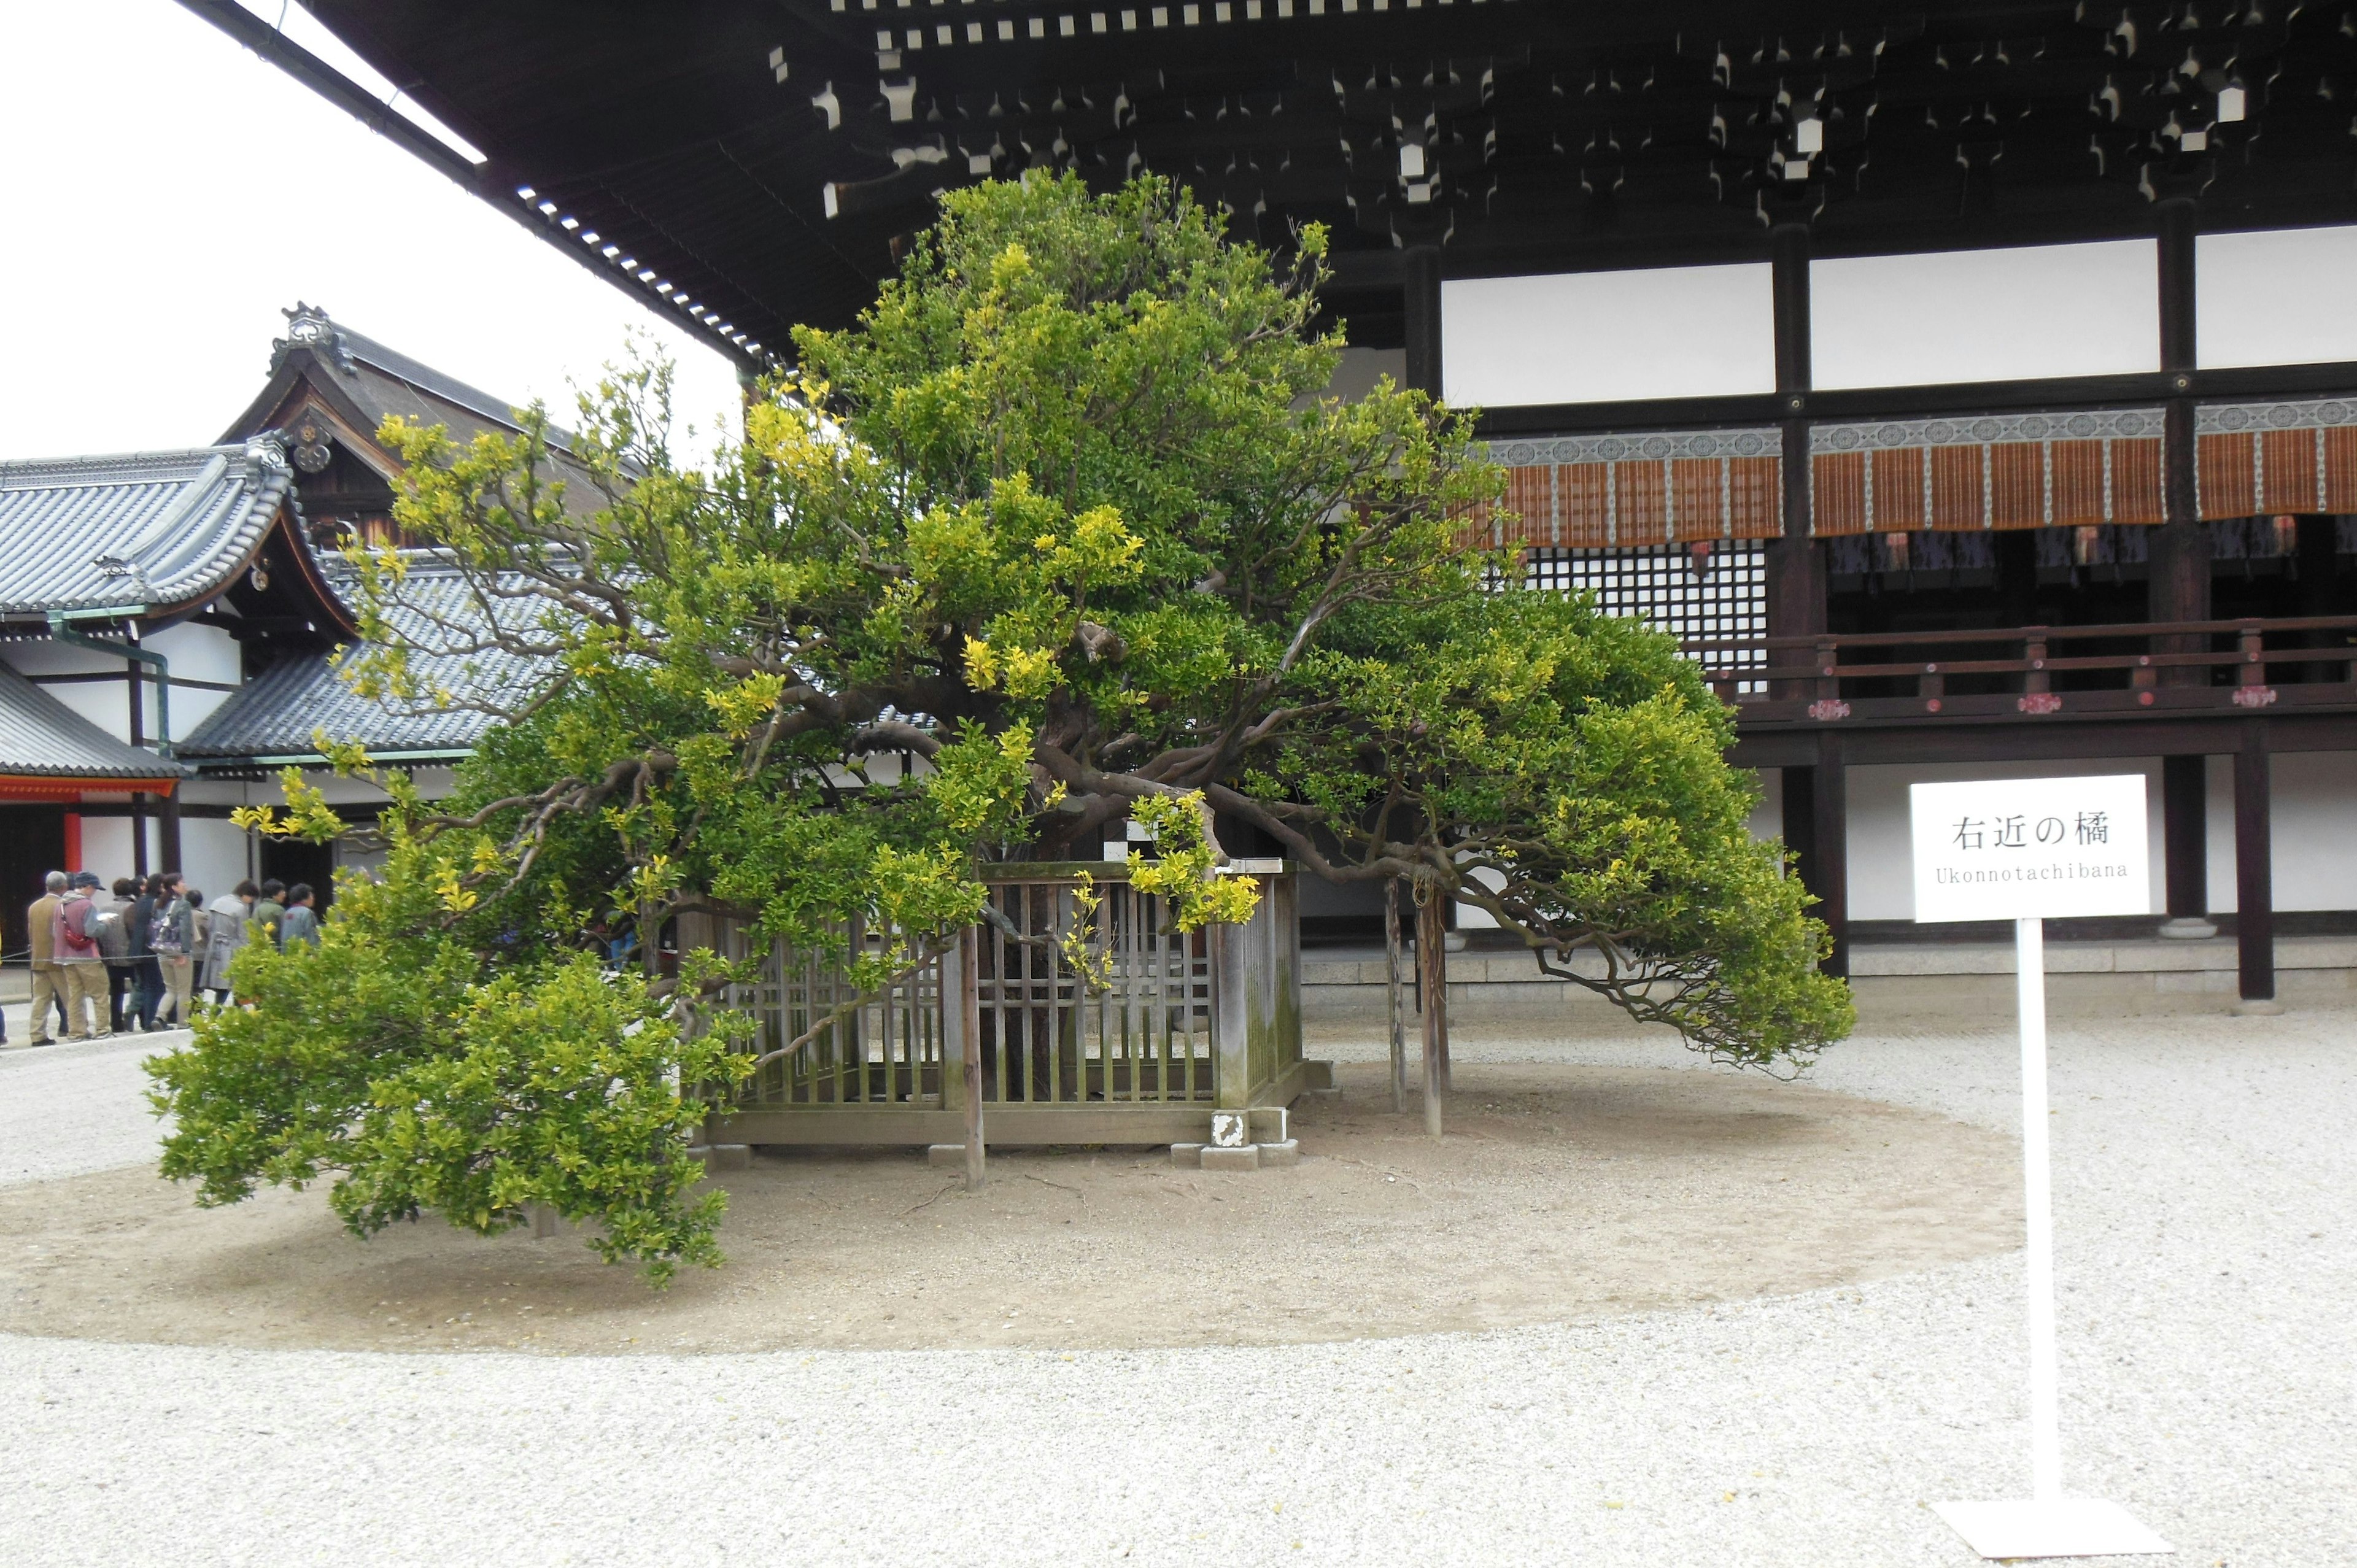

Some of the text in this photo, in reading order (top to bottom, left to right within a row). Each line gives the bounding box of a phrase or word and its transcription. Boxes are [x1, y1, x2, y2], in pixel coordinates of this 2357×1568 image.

[1952, 811, 2109, 851] 右近の橘
[1936, 862, 2128, 884] Ukonnotachibana
